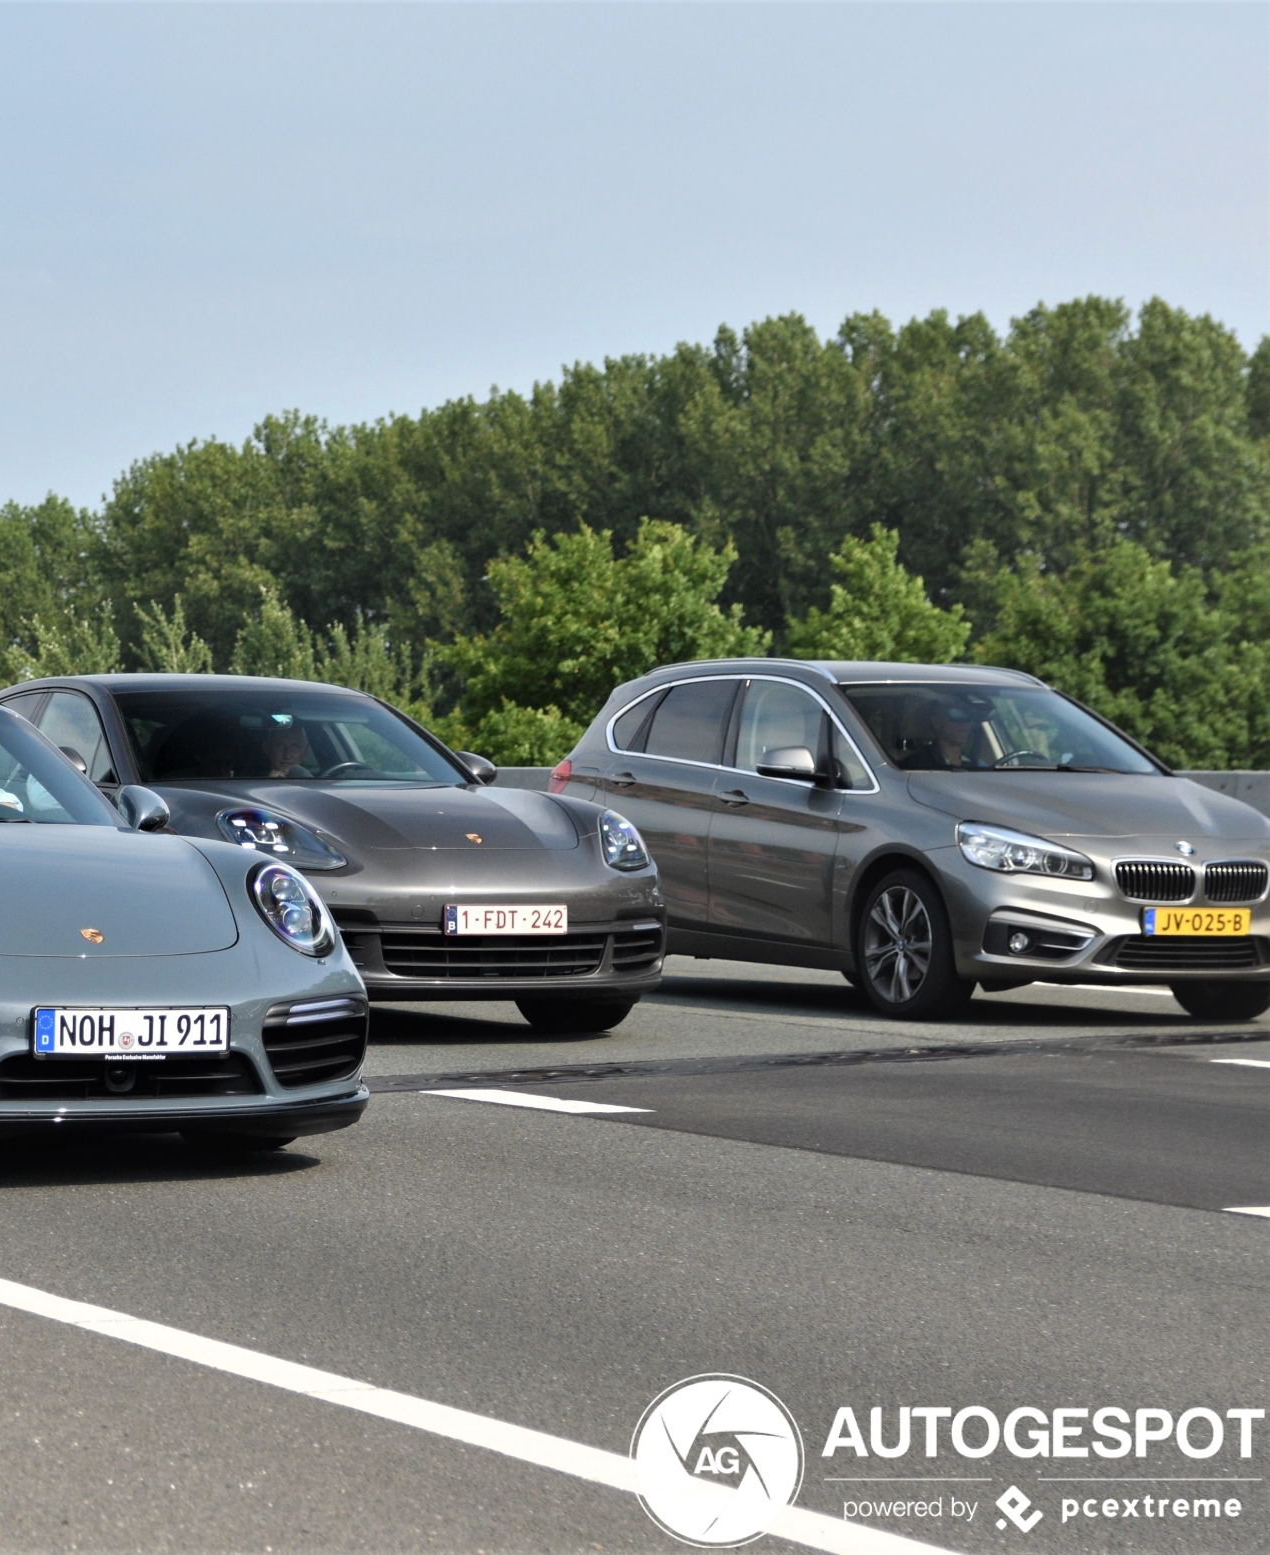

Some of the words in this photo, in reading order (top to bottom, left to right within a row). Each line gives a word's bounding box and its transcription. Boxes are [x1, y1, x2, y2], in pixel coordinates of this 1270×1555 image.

[448, 921, 456, 930] B
[461, 909, 563, 929] 1-FDT-242
[1161, 913, 1243, 932] JV-025-B
[59, 1014, 115, 1047] NOH
[137, 1014, 168, 1047] JI
[176, 1013, 223, 1046] 911
[41, 1035, 49, 1045] D
